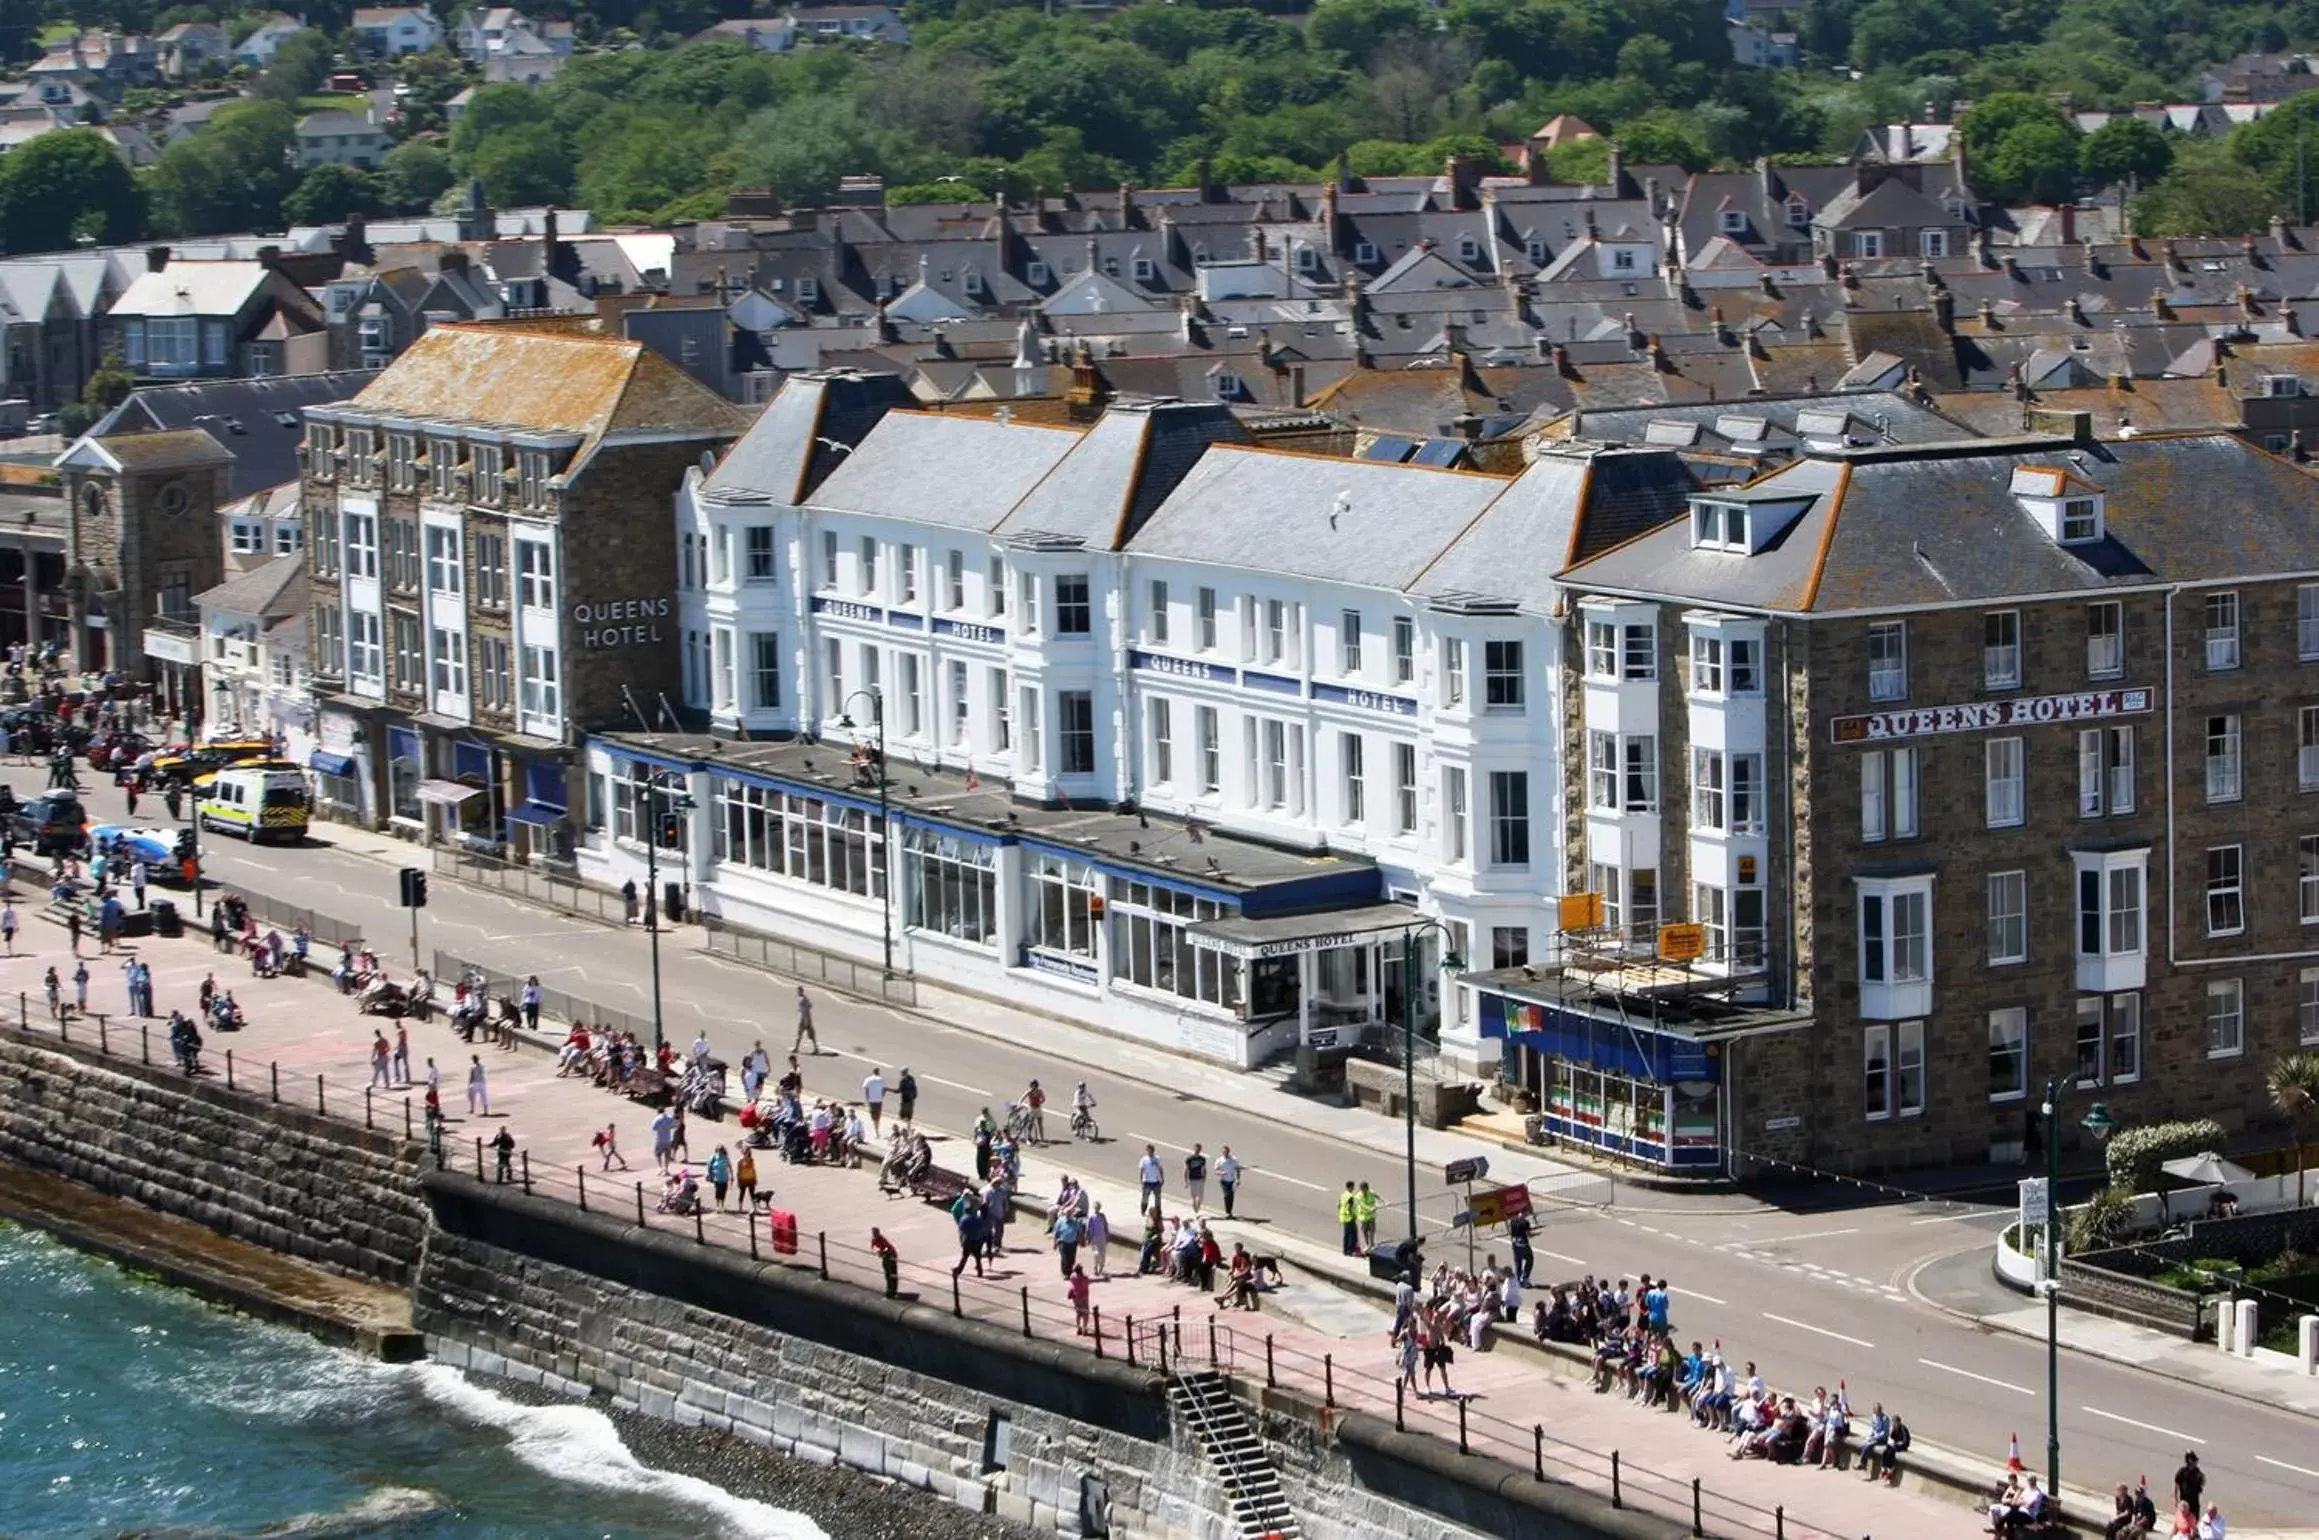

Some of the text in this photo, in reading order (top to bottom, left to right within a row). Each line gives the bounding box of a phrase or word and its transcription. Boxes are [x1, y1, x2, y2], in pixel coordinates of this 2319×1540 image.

[574, 599, 668, 622] QUEENS
[584, 625, 662, 647] HOTEL
[951, 621, 993, 642] HOTEL
[1151, 655, 1403, 713] QUEENS HOTEL
[1867, 701, 2001, 739] QUEENS
[2008, 692, 2117, 724] HOTEL
[1260, 938, 1311, 956] QUEENS
[1315, 931, 1356, 948] HOTEL
